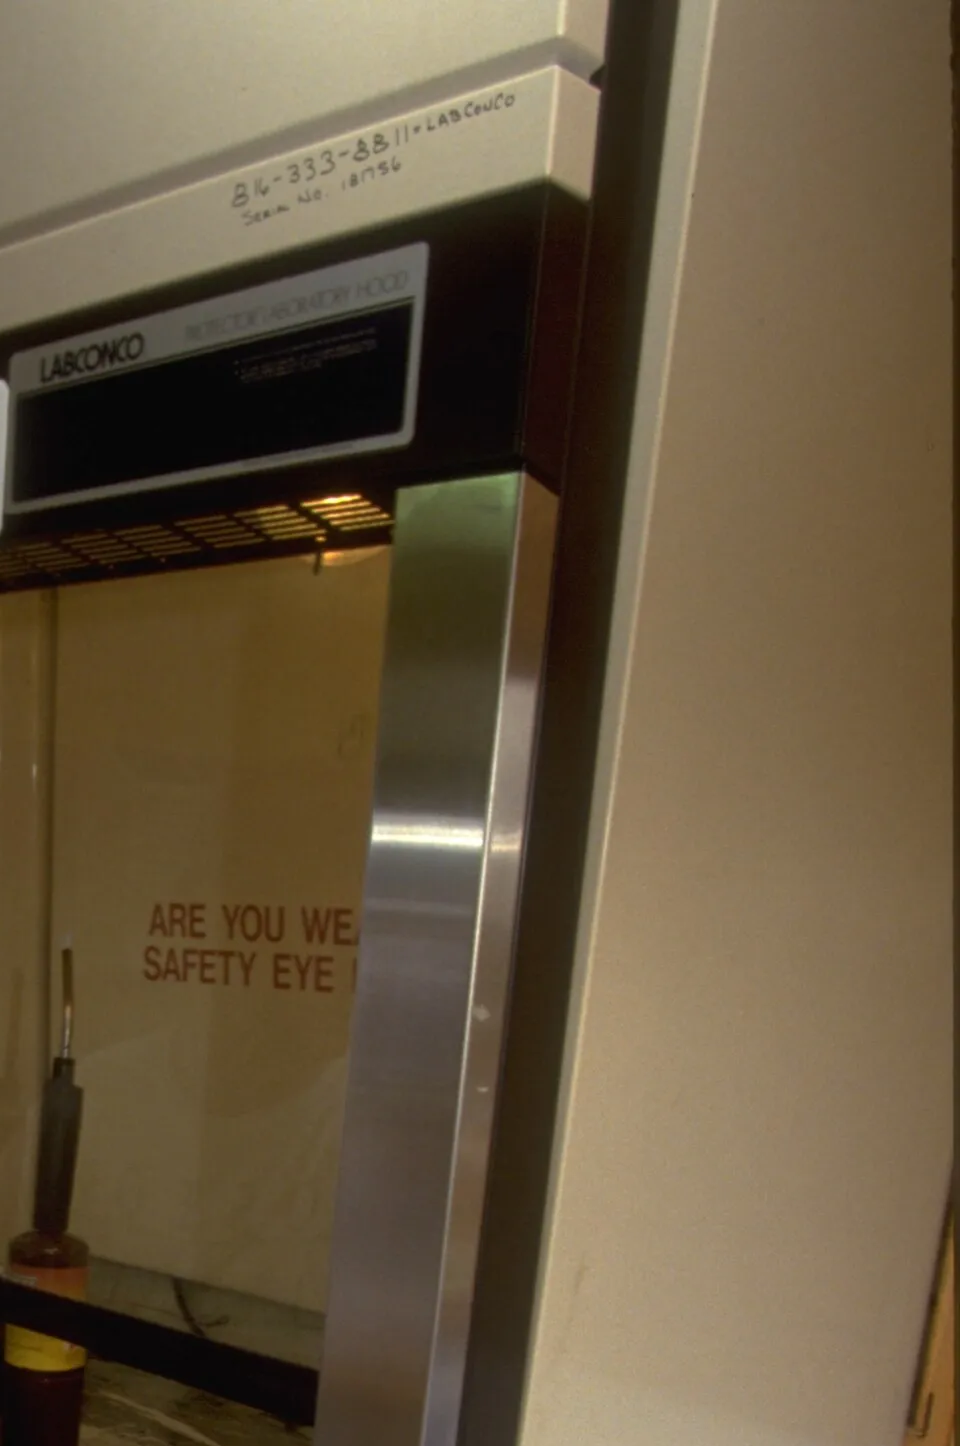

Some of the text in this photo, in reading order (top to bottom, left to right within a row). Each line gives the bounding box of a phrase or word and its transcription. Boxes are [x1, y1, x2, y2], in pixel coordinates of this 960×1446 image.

[355, 269, 411, 299] HOOD
[40, 333, 145, 384] LABCONCO
[148, 903, 207, 939] ARE
[221, 904, 286, 943] YOU
[143, 946, 257, 987] SAFETY
[273, 953, 335, 993] EYE
